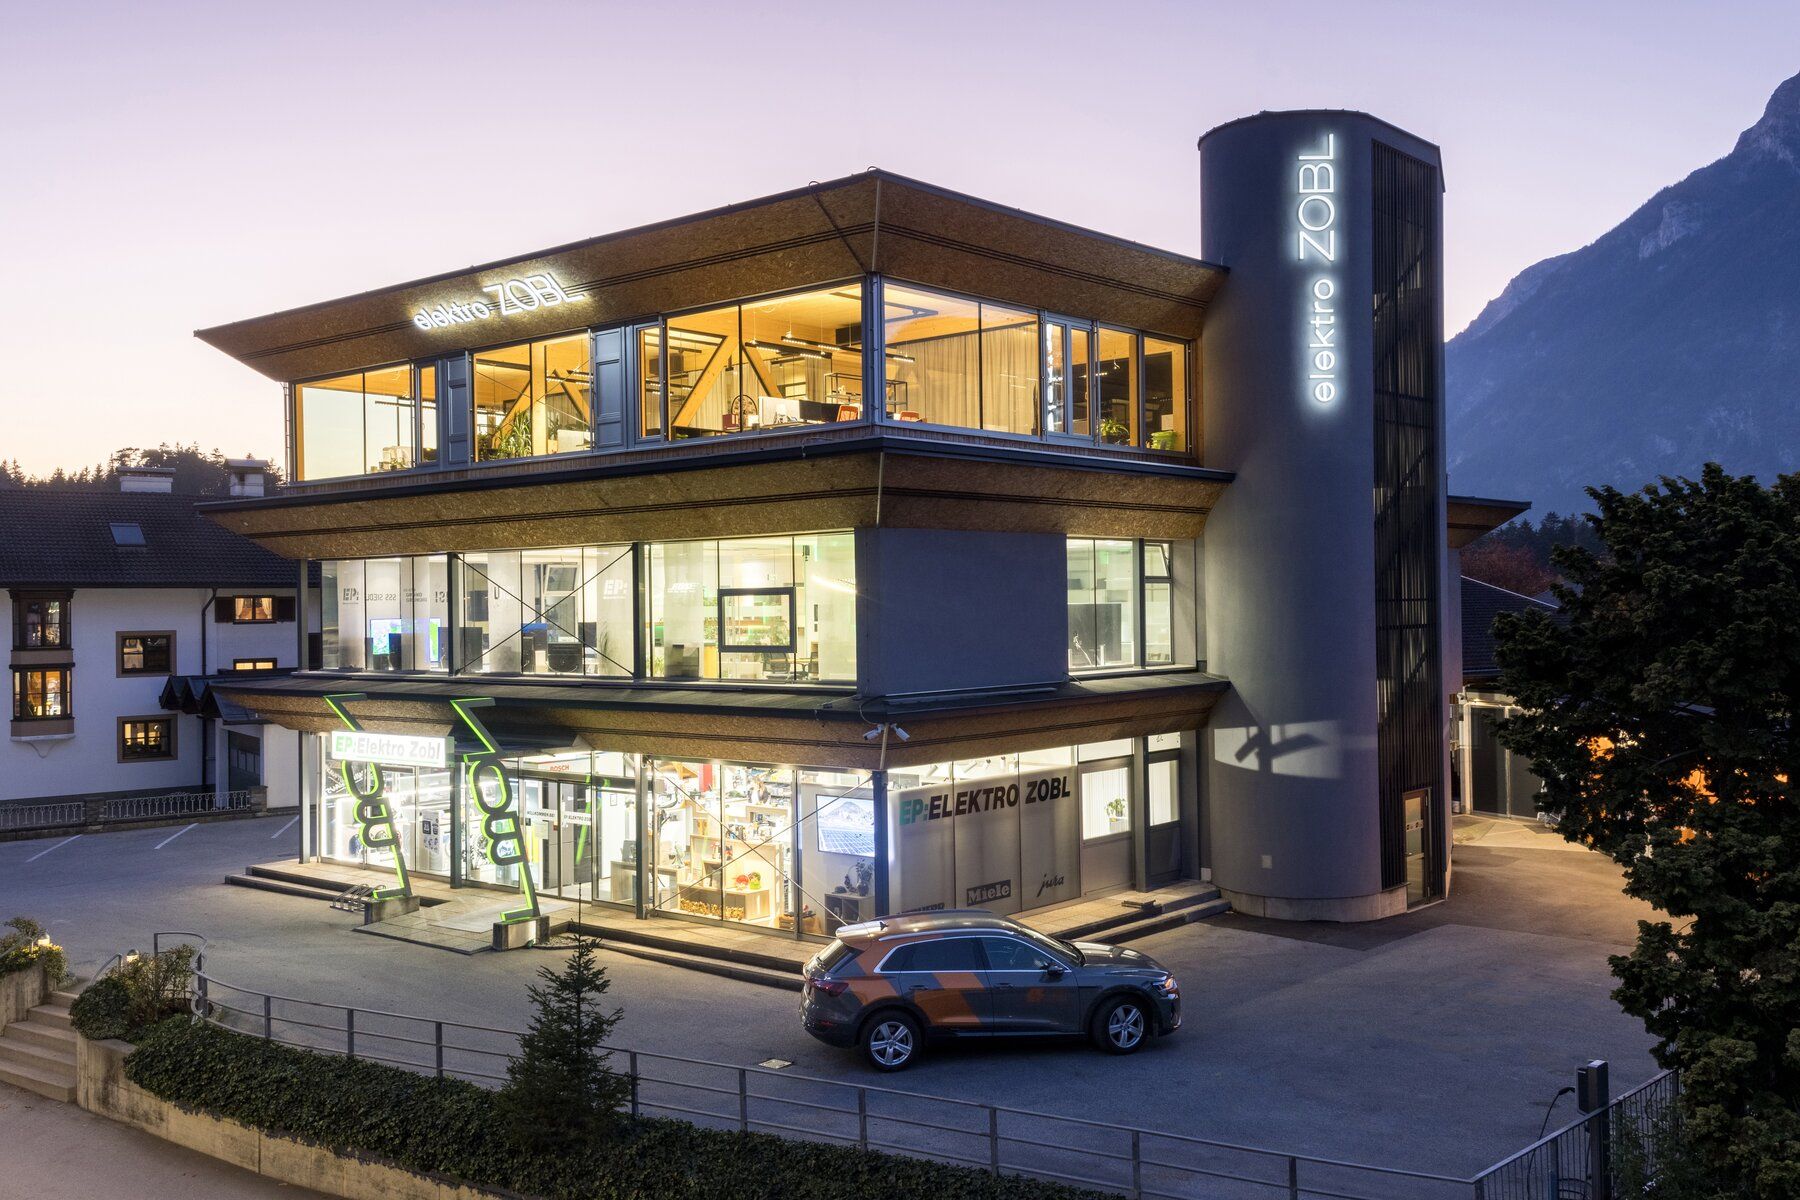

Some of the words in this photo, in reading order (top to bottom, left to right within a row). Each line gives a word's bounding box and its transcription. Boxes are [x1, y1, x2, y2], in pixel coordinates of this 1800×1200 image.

[1298, 133, 1335, 262] ZOBL
[413, 303, 491, 330] elektro
[483, 273, 584, 316] ZOBL
[1310, 279, 1335, 402] elektro
[409, 740, 441, 759] Zobl
[1025, 776, 1071, 804] ZOBL
[968, 884, 1010, 905] Miele
[1037, 874, 1065, 897] jura
